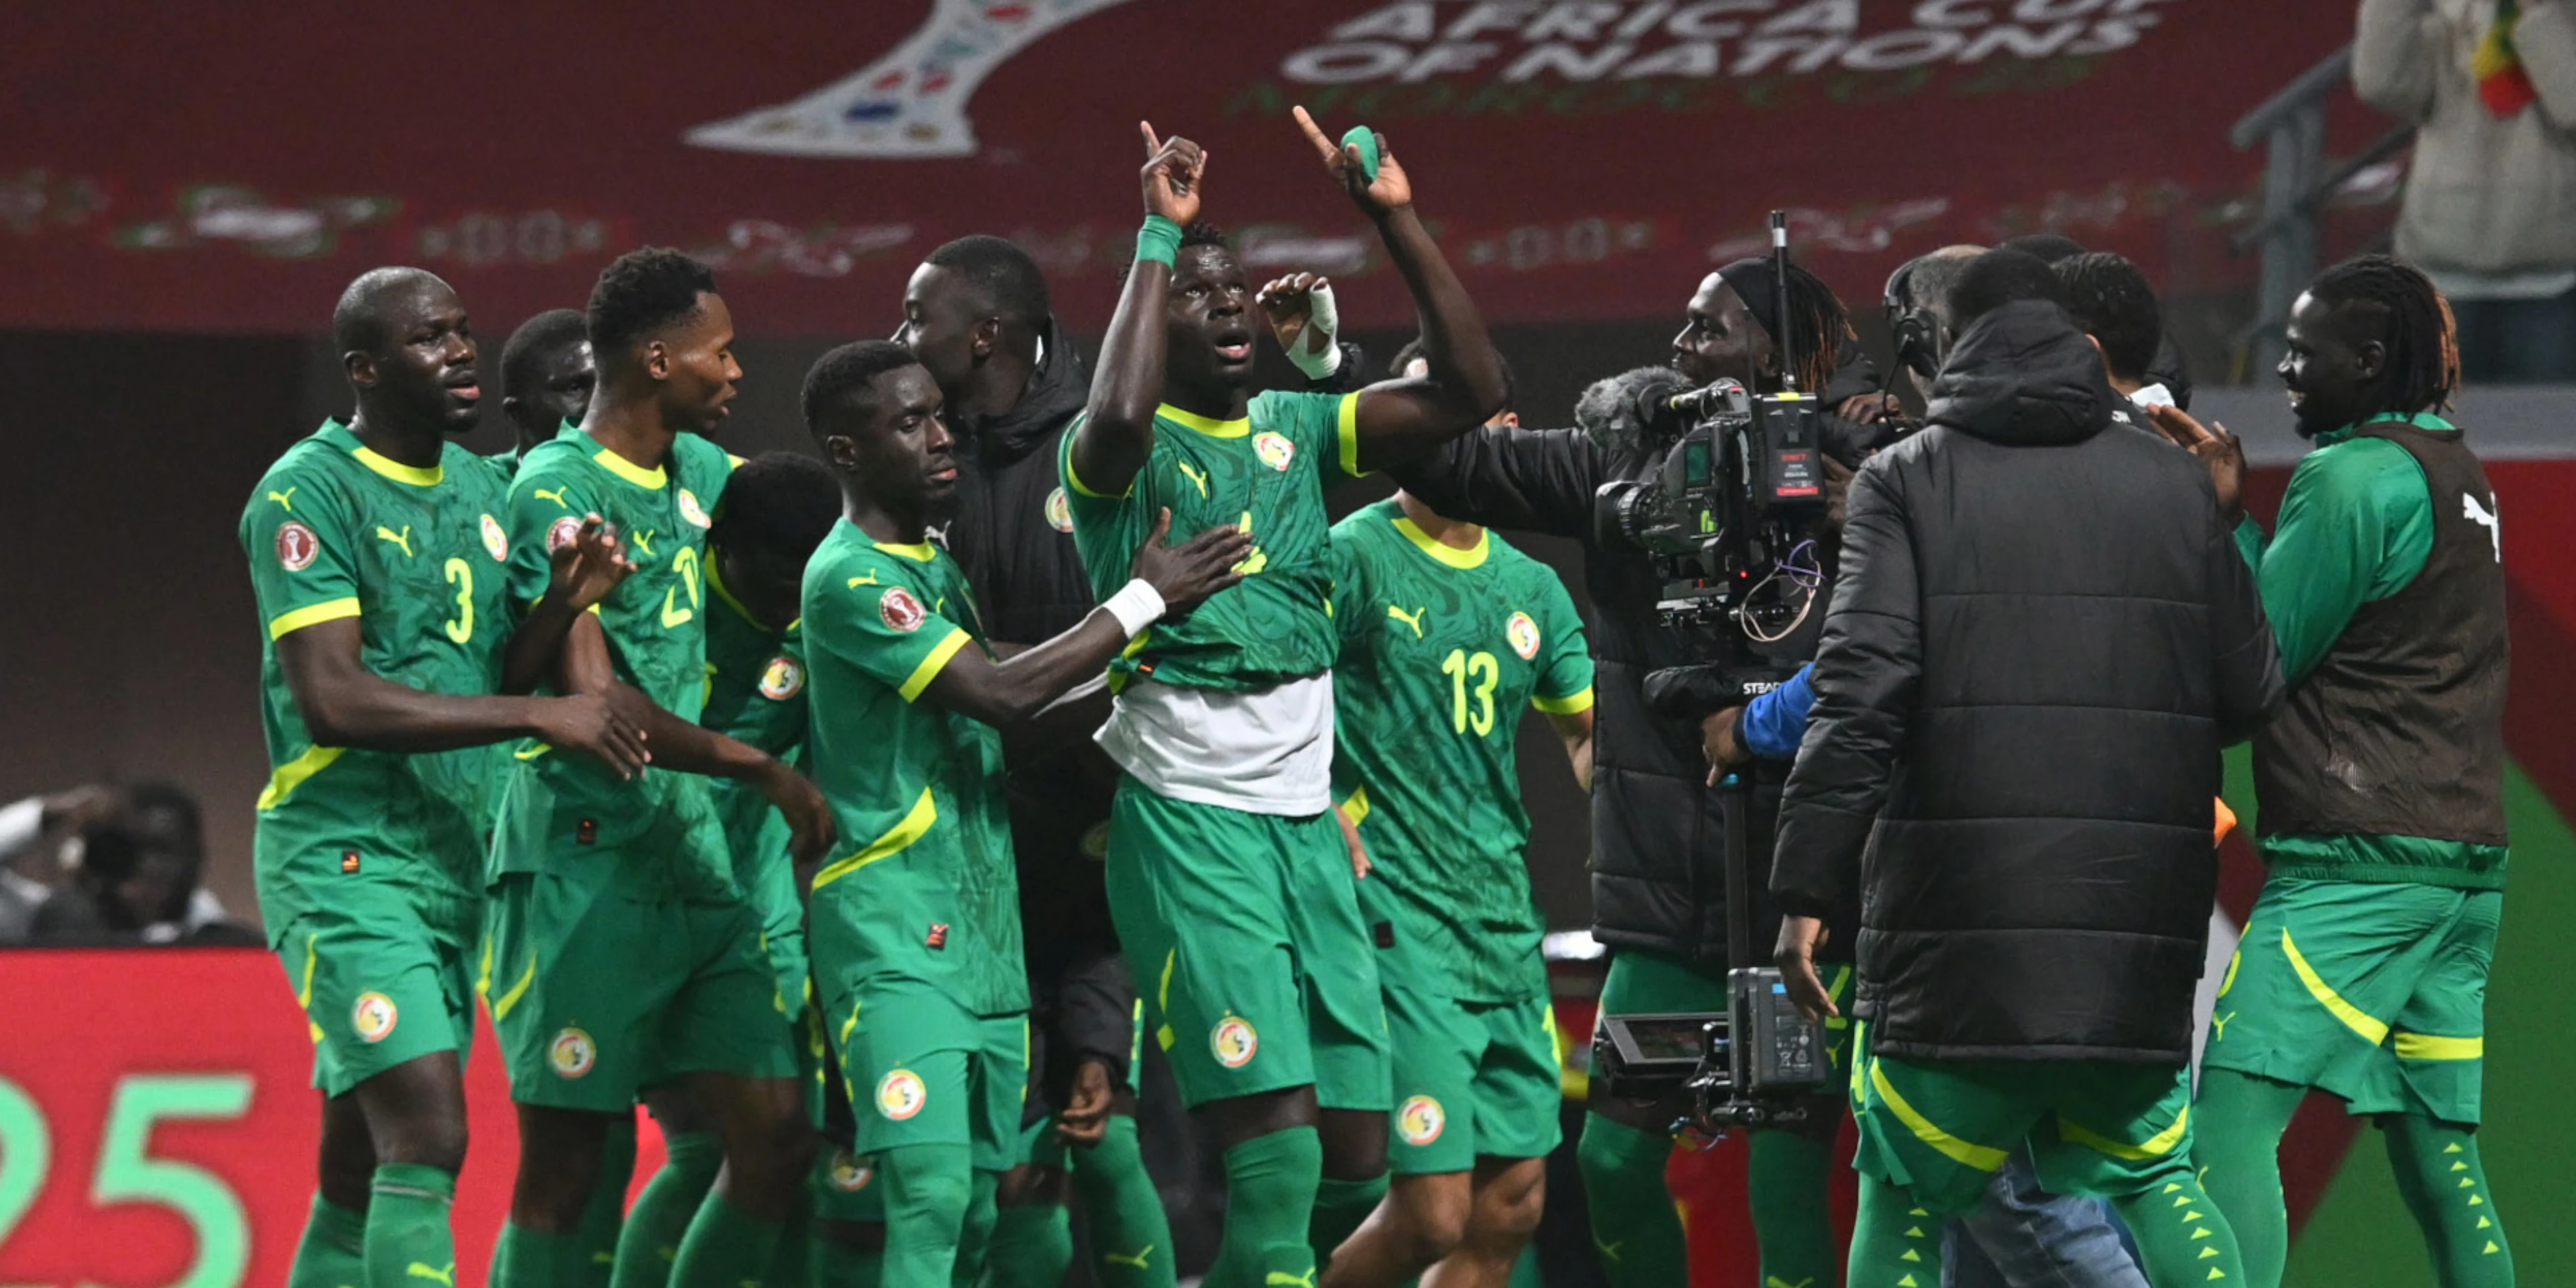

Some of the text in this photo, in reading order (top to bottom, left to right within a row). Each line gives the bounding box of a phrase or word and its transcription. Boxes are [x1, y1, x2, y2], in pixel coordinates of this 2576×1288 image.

[1281, 11, 2161, 83] OF NATIONS
[1328, 0, 1859, 40] AFRICA
[445, 557, 474, 643] 3
[1442, 649, 1499, 737] 13
